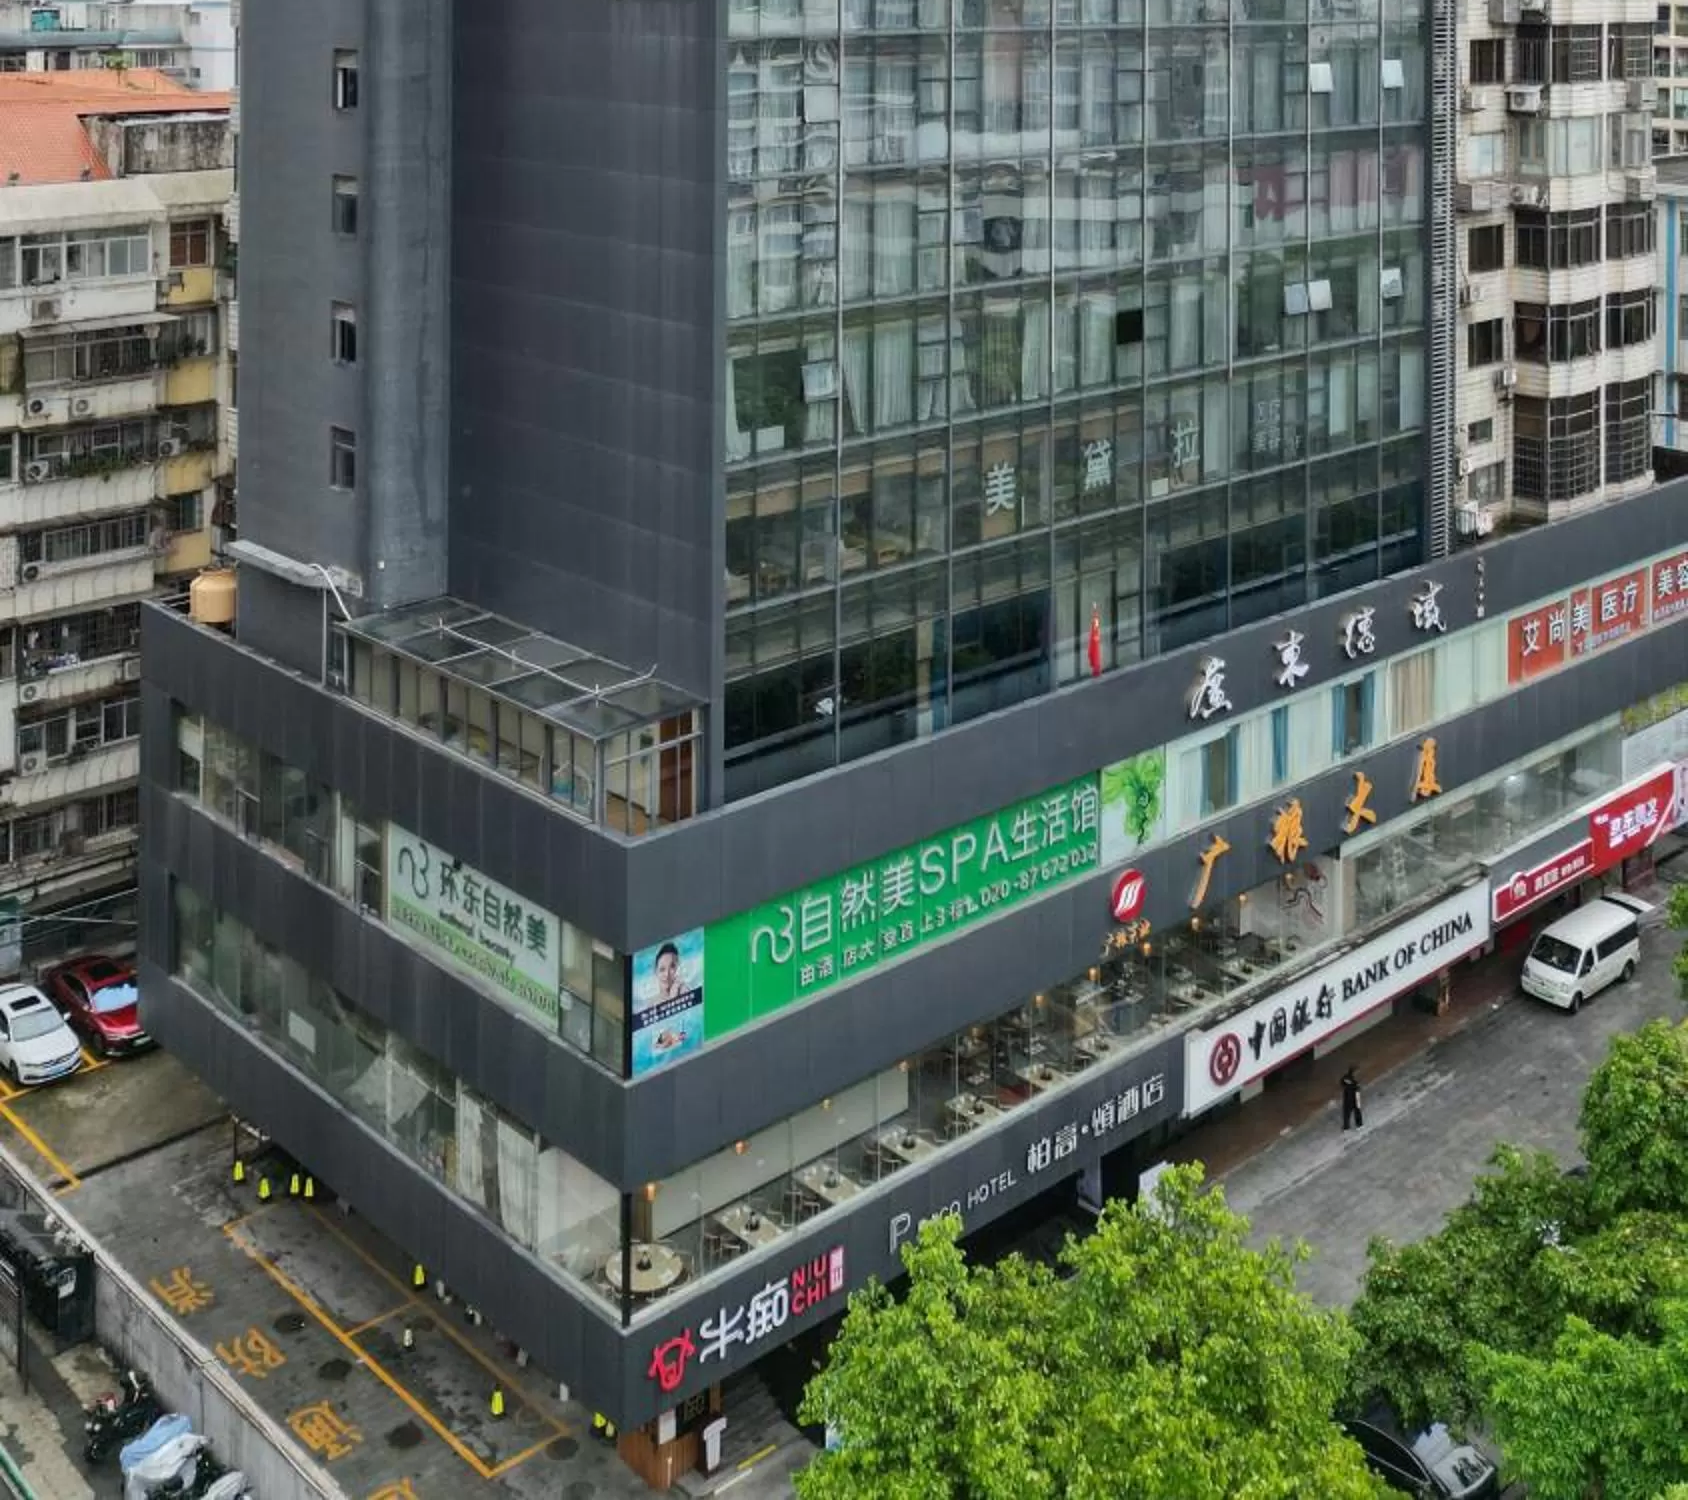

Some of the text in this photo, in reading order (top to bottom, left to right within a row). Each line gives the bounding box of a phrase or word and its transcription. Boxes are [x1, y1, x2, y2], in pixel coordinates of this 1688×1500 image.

[1341, 955, 1390, 1000] BANK
[1394, 941, 1417, 971] OF
[1419, 911, 1473, 957] CHINA
[966, 1169, 1018, 1210] HOTEL
[792, 1253, 828, 1288] NIU
[791, 1278, 828, 1317] CHI
